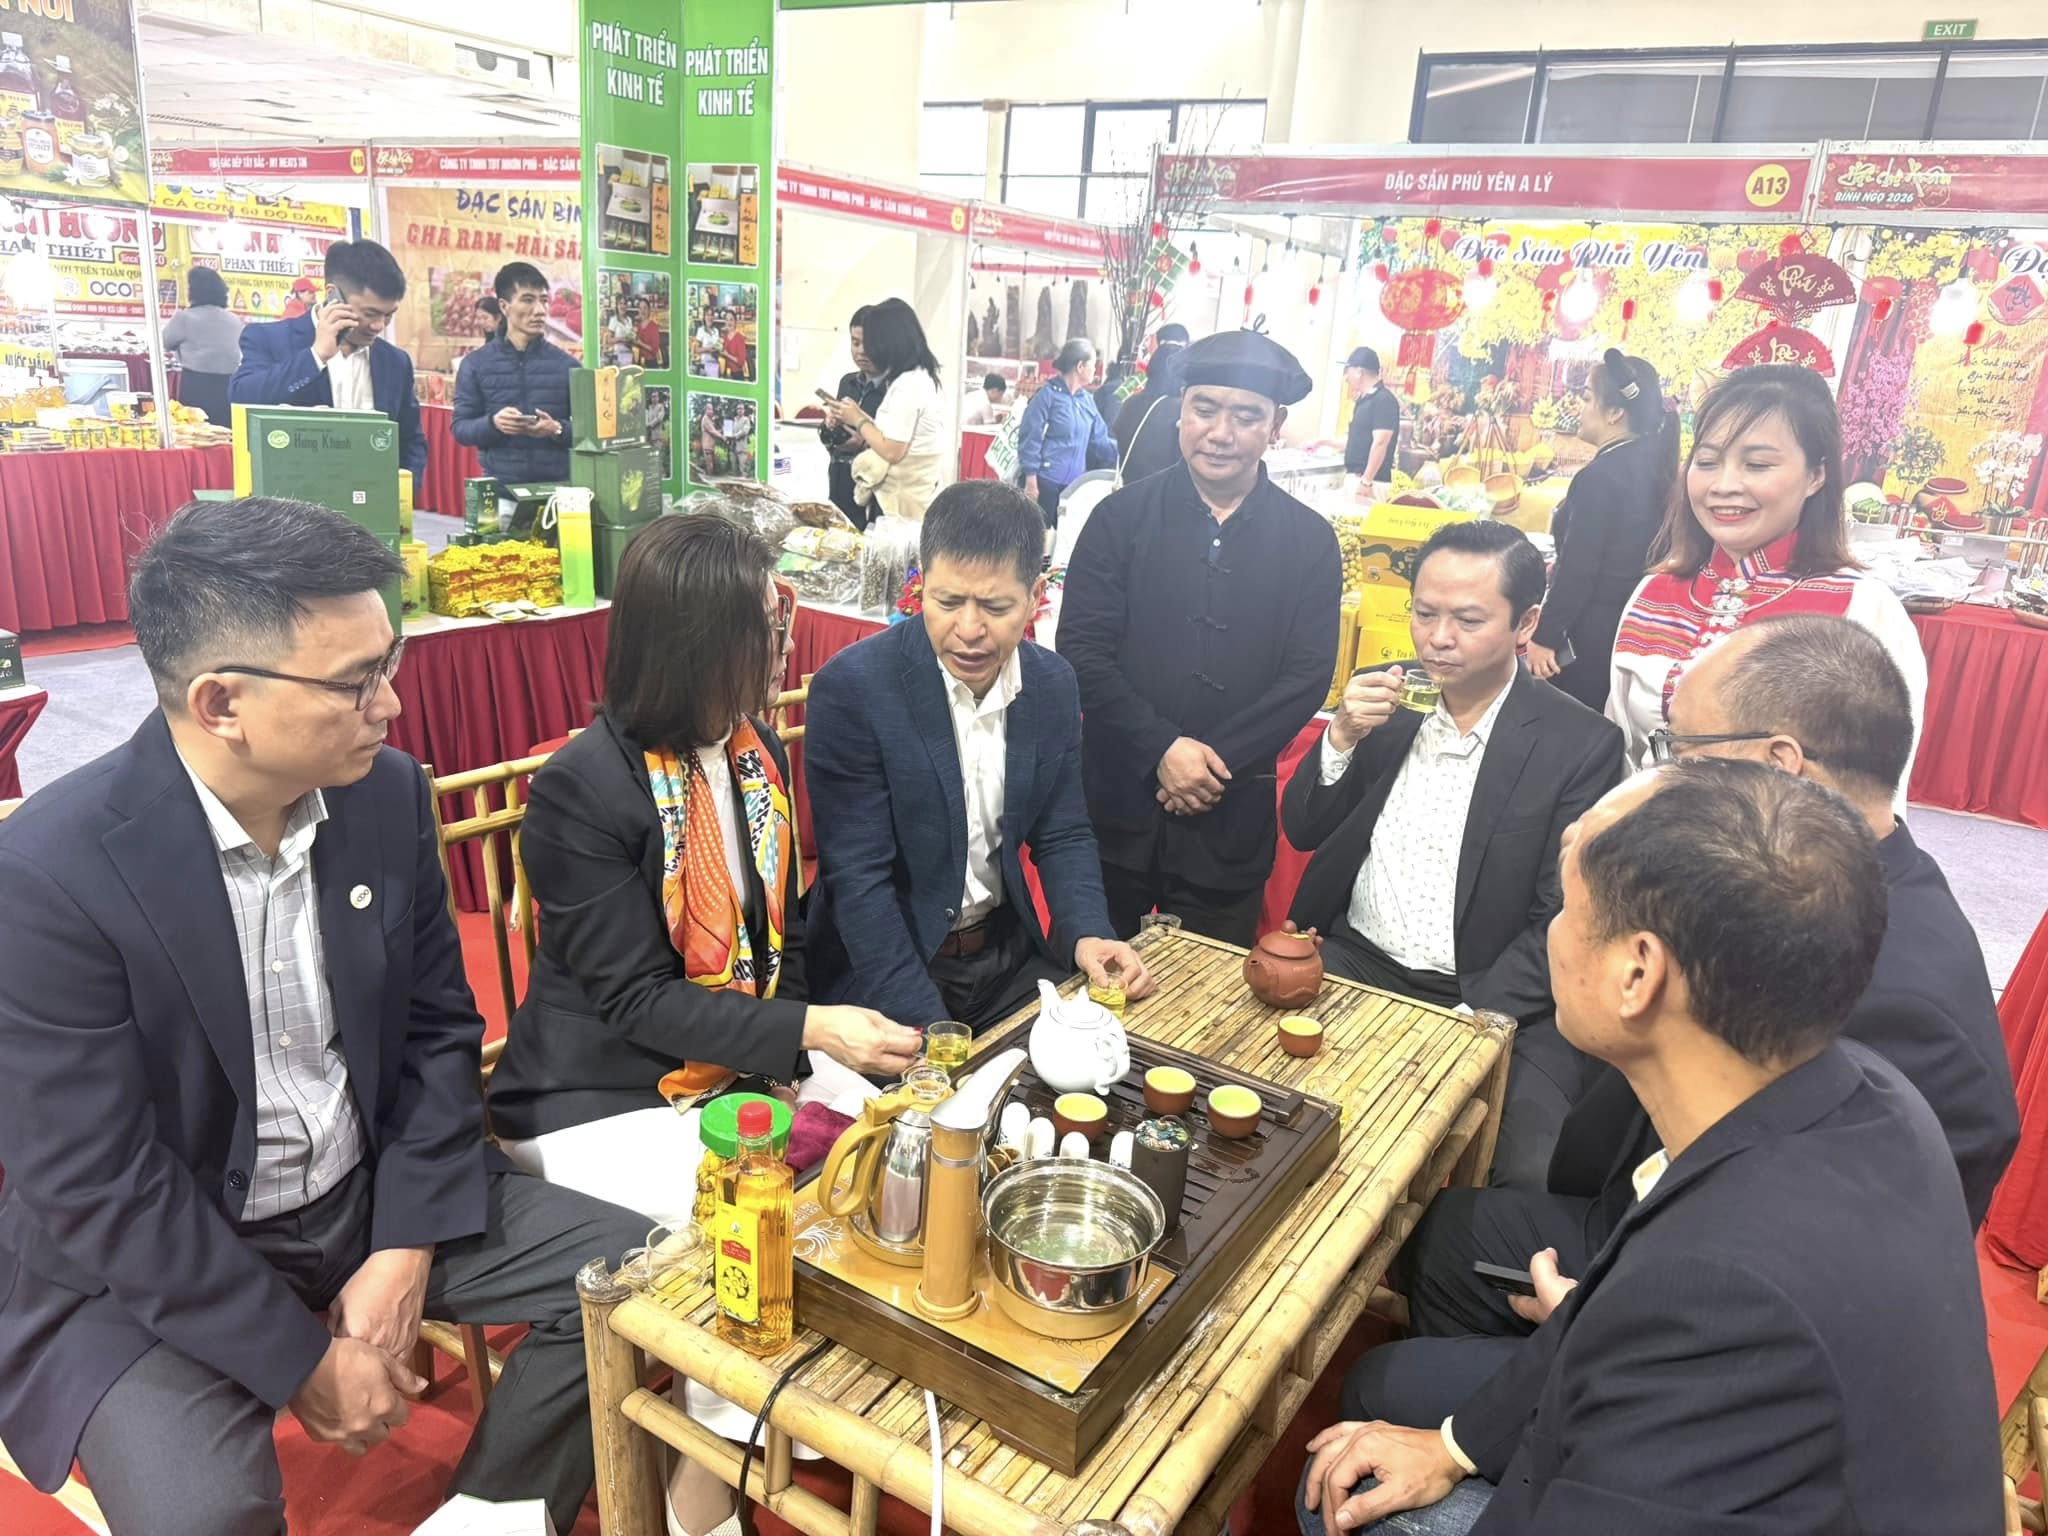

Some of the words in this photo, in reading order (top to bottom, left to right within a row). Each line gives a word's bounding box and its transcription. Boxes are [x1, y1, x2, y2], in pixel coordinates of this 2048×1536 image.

[1934, 23, 1967, 36] EXIT
[591, 21, 632, 57] PHÁT
[634, 29, 677, 69] TRIỂN
[685, 44, 723, 76] PHÁT
[725, 36, 769, 75] TRIỂN
[607, 67, 643, 102] KINH
[647, 72, 664, 106] TẾ
[698, 89, 733, 116] KINH
[737, 80, 755, 116] TẾ
[440, 156, 458, 170] CÔNG
[460, 158, 468, 170] TY
[1385, 170, 1414, 201] ĐẶC
[1417, 168, 1449, 191] SẢN
[1451, 170, 1483, 191] PHÚ
[1487, 170, 1516, 192] YÊN
[1519, 174, 1529, 192] A
[1533, 171, 1553, 192] LÝ
[1751, 176, 1788, 197] A13
[1887, 192, 1915, 203] 2026
[406, 219, 450, 248] CHẢ
[456, 227, 502, 253] RAM
[46, 241, 106, 259] THIẾT
[224, 257, 256, 271] PHAN
[259, 256, 295, 273] THIẾT
[90, 280, 144, 298] OCOP
